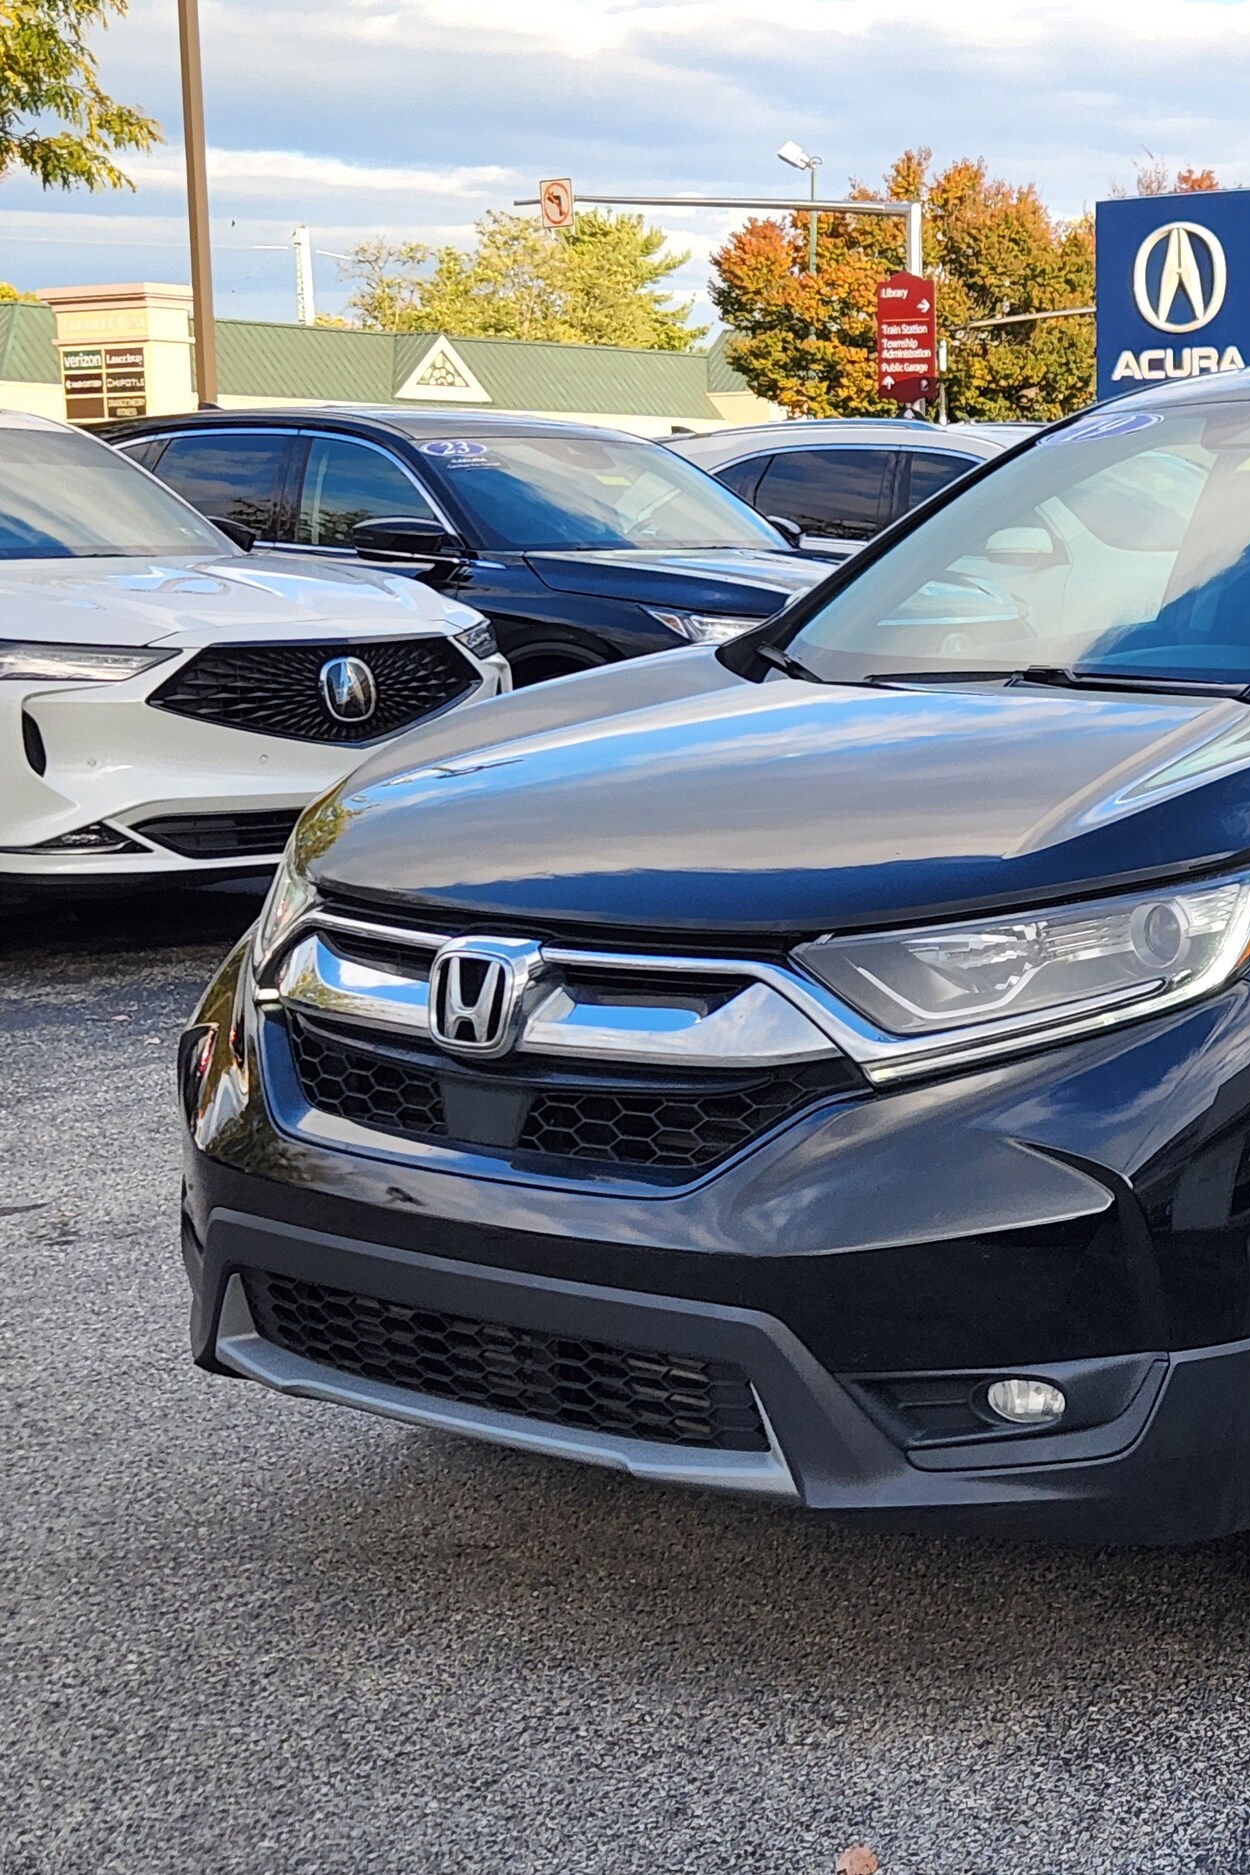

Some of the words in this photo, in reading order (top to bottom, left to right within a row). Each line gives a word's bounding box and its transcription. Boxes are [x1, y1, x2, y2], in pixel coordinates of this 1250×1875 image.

[880, 287, 908, 299] Library
[881, 324, 901, 335] Train
[901, 323, 928, 334] Station
[881, 338, 918, 349] Township
[881, 348, 931, 359] Administration
[63, 352, 101, 368] verizon
[1111, 345, 1246, 381] ACURA
[881, 363, 904, 372] Public
[904, 363, 928, 374] Garage
[440, 441, 471, 455] 23
